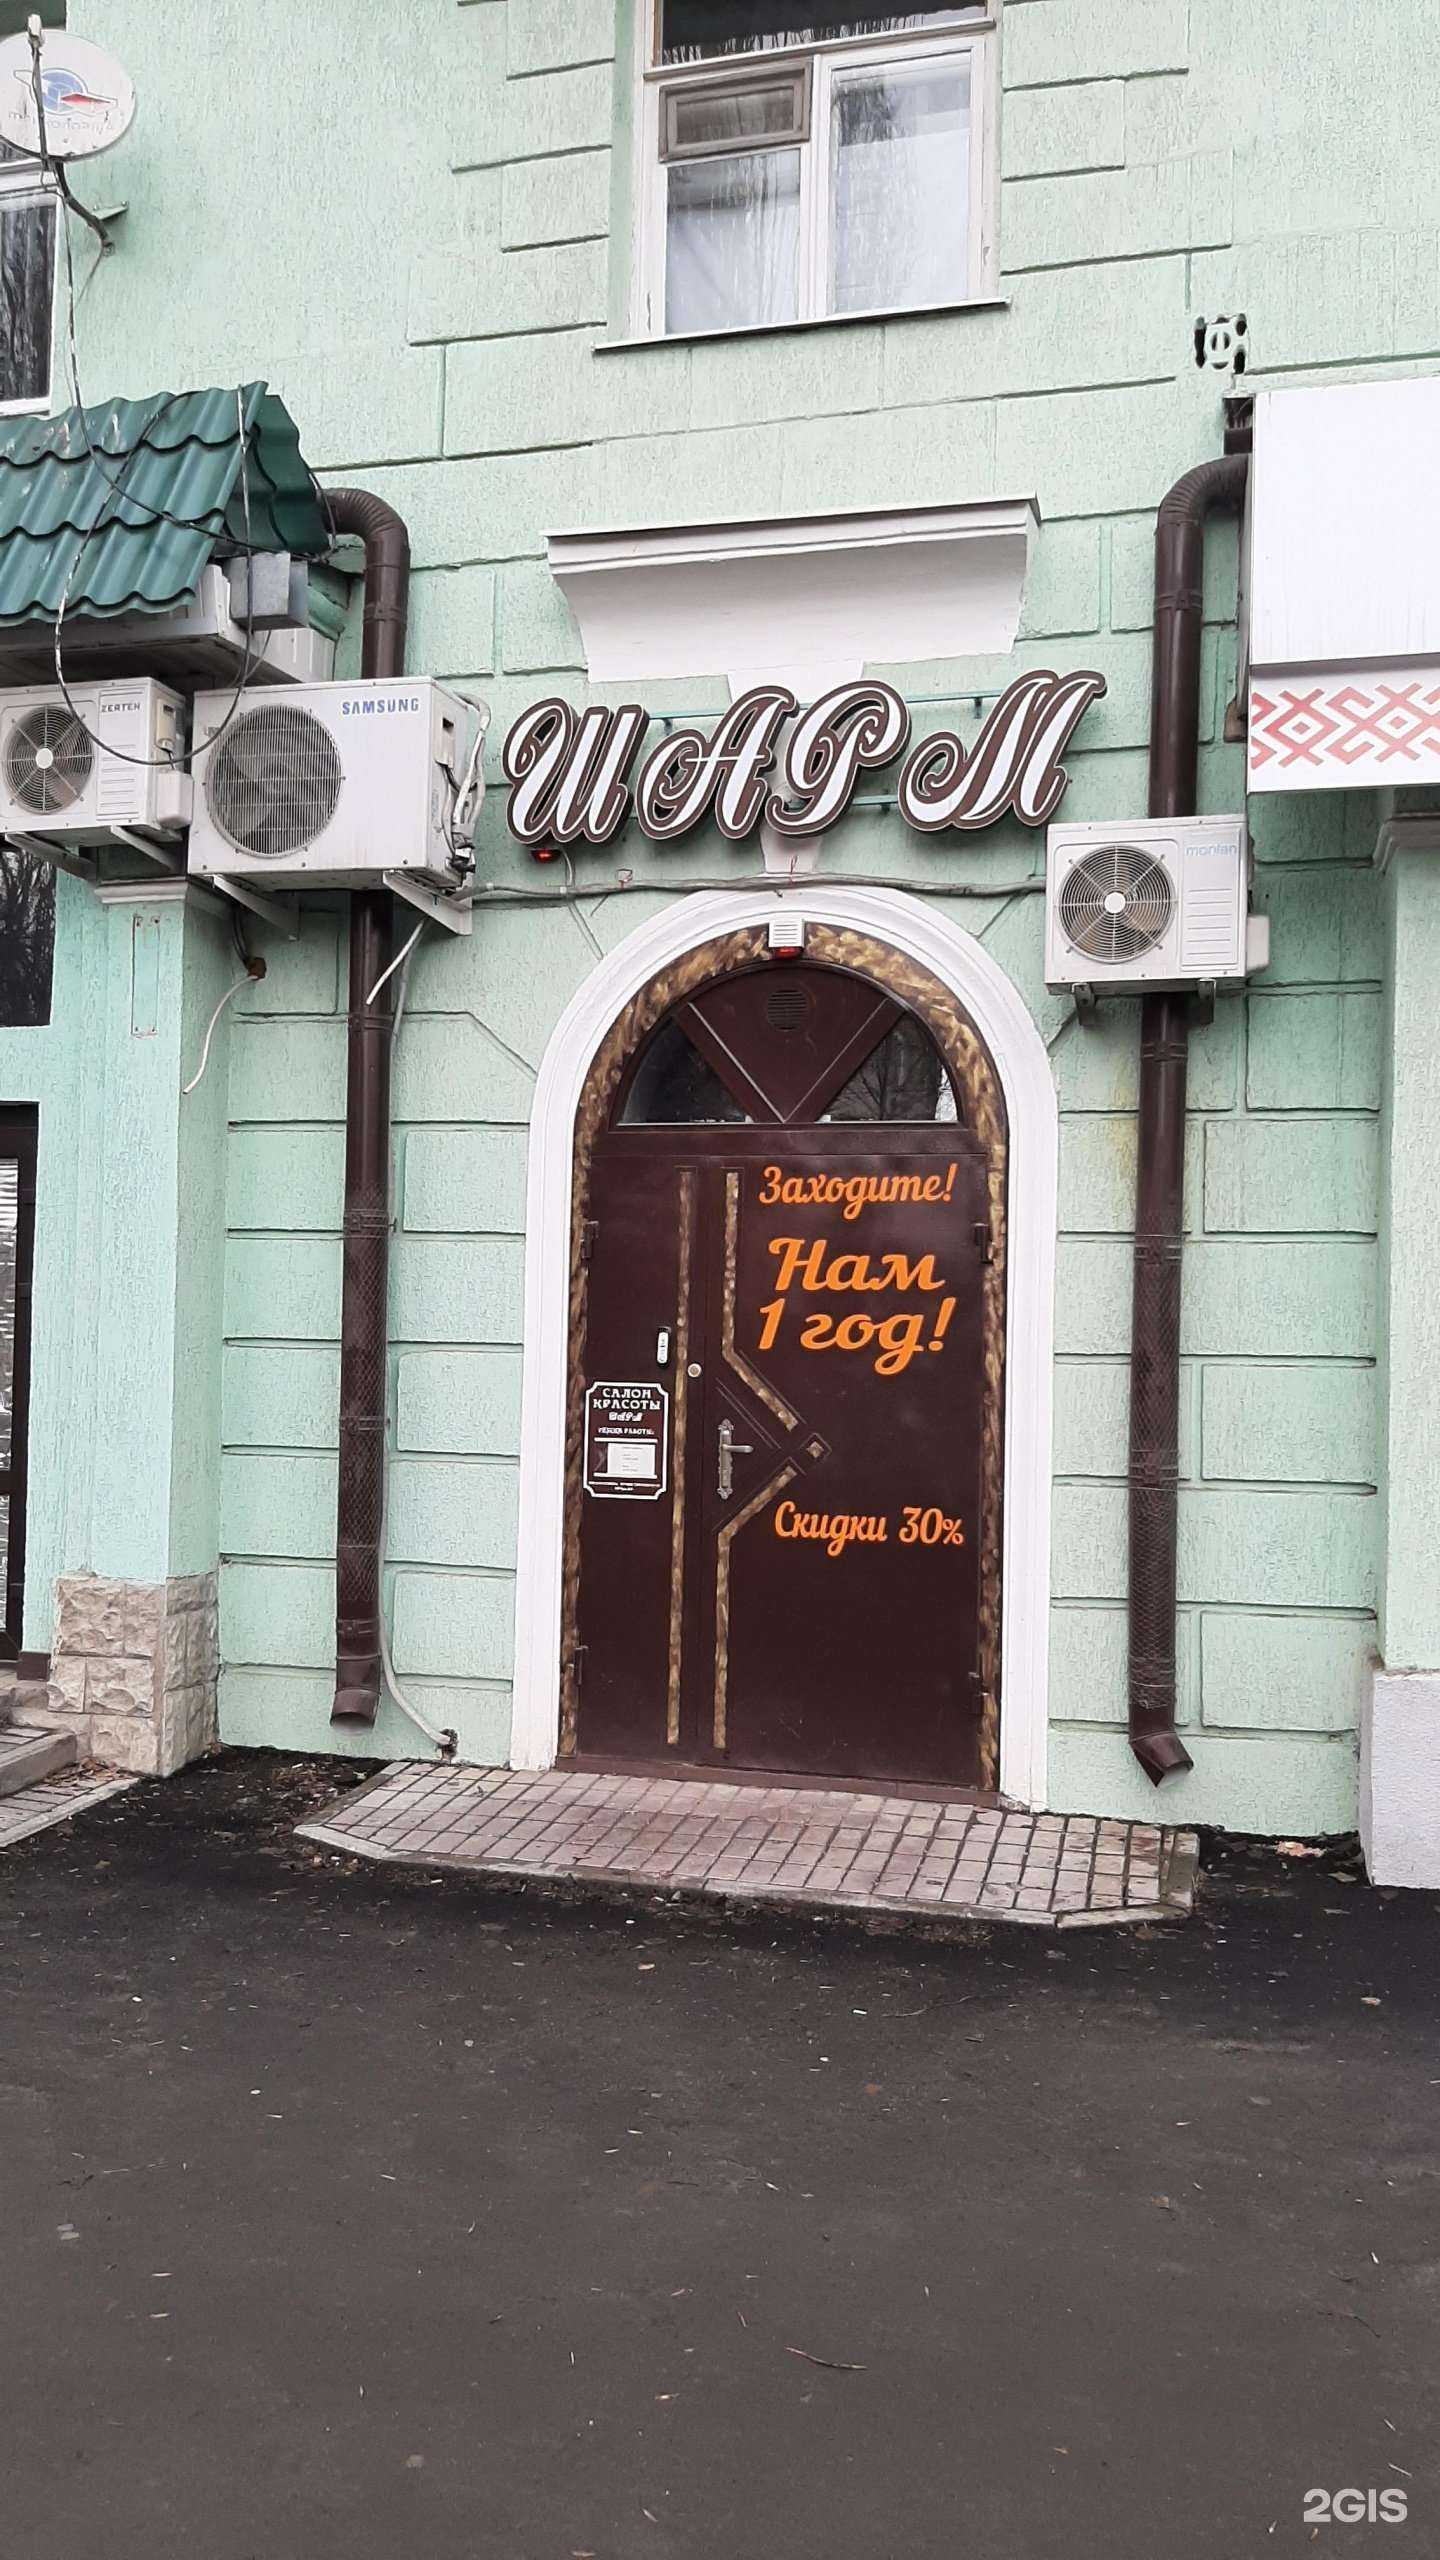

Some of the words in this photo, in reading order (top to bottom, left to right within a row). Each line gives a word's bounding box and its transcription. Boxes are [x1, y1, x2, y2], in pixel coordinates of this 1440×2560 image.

[342, 698, 419, 715] SAMSUNG
[503, 669, 1107, 844] ШАРМ
[759, 1163, 958, 1220] Заходите!
[768, 1237, 946, 1291] Нам
[758, 1298, 785, 1350] 1
[800, 1297, 957, 1375] год!
[593, 1399, 661, 1410] КРАСОТЫ
[602, 1388, 651, 1399] САЛОН
[774, 1500, 888, 1557] Скидки
[898, 1507, 964, 1545] 30%
